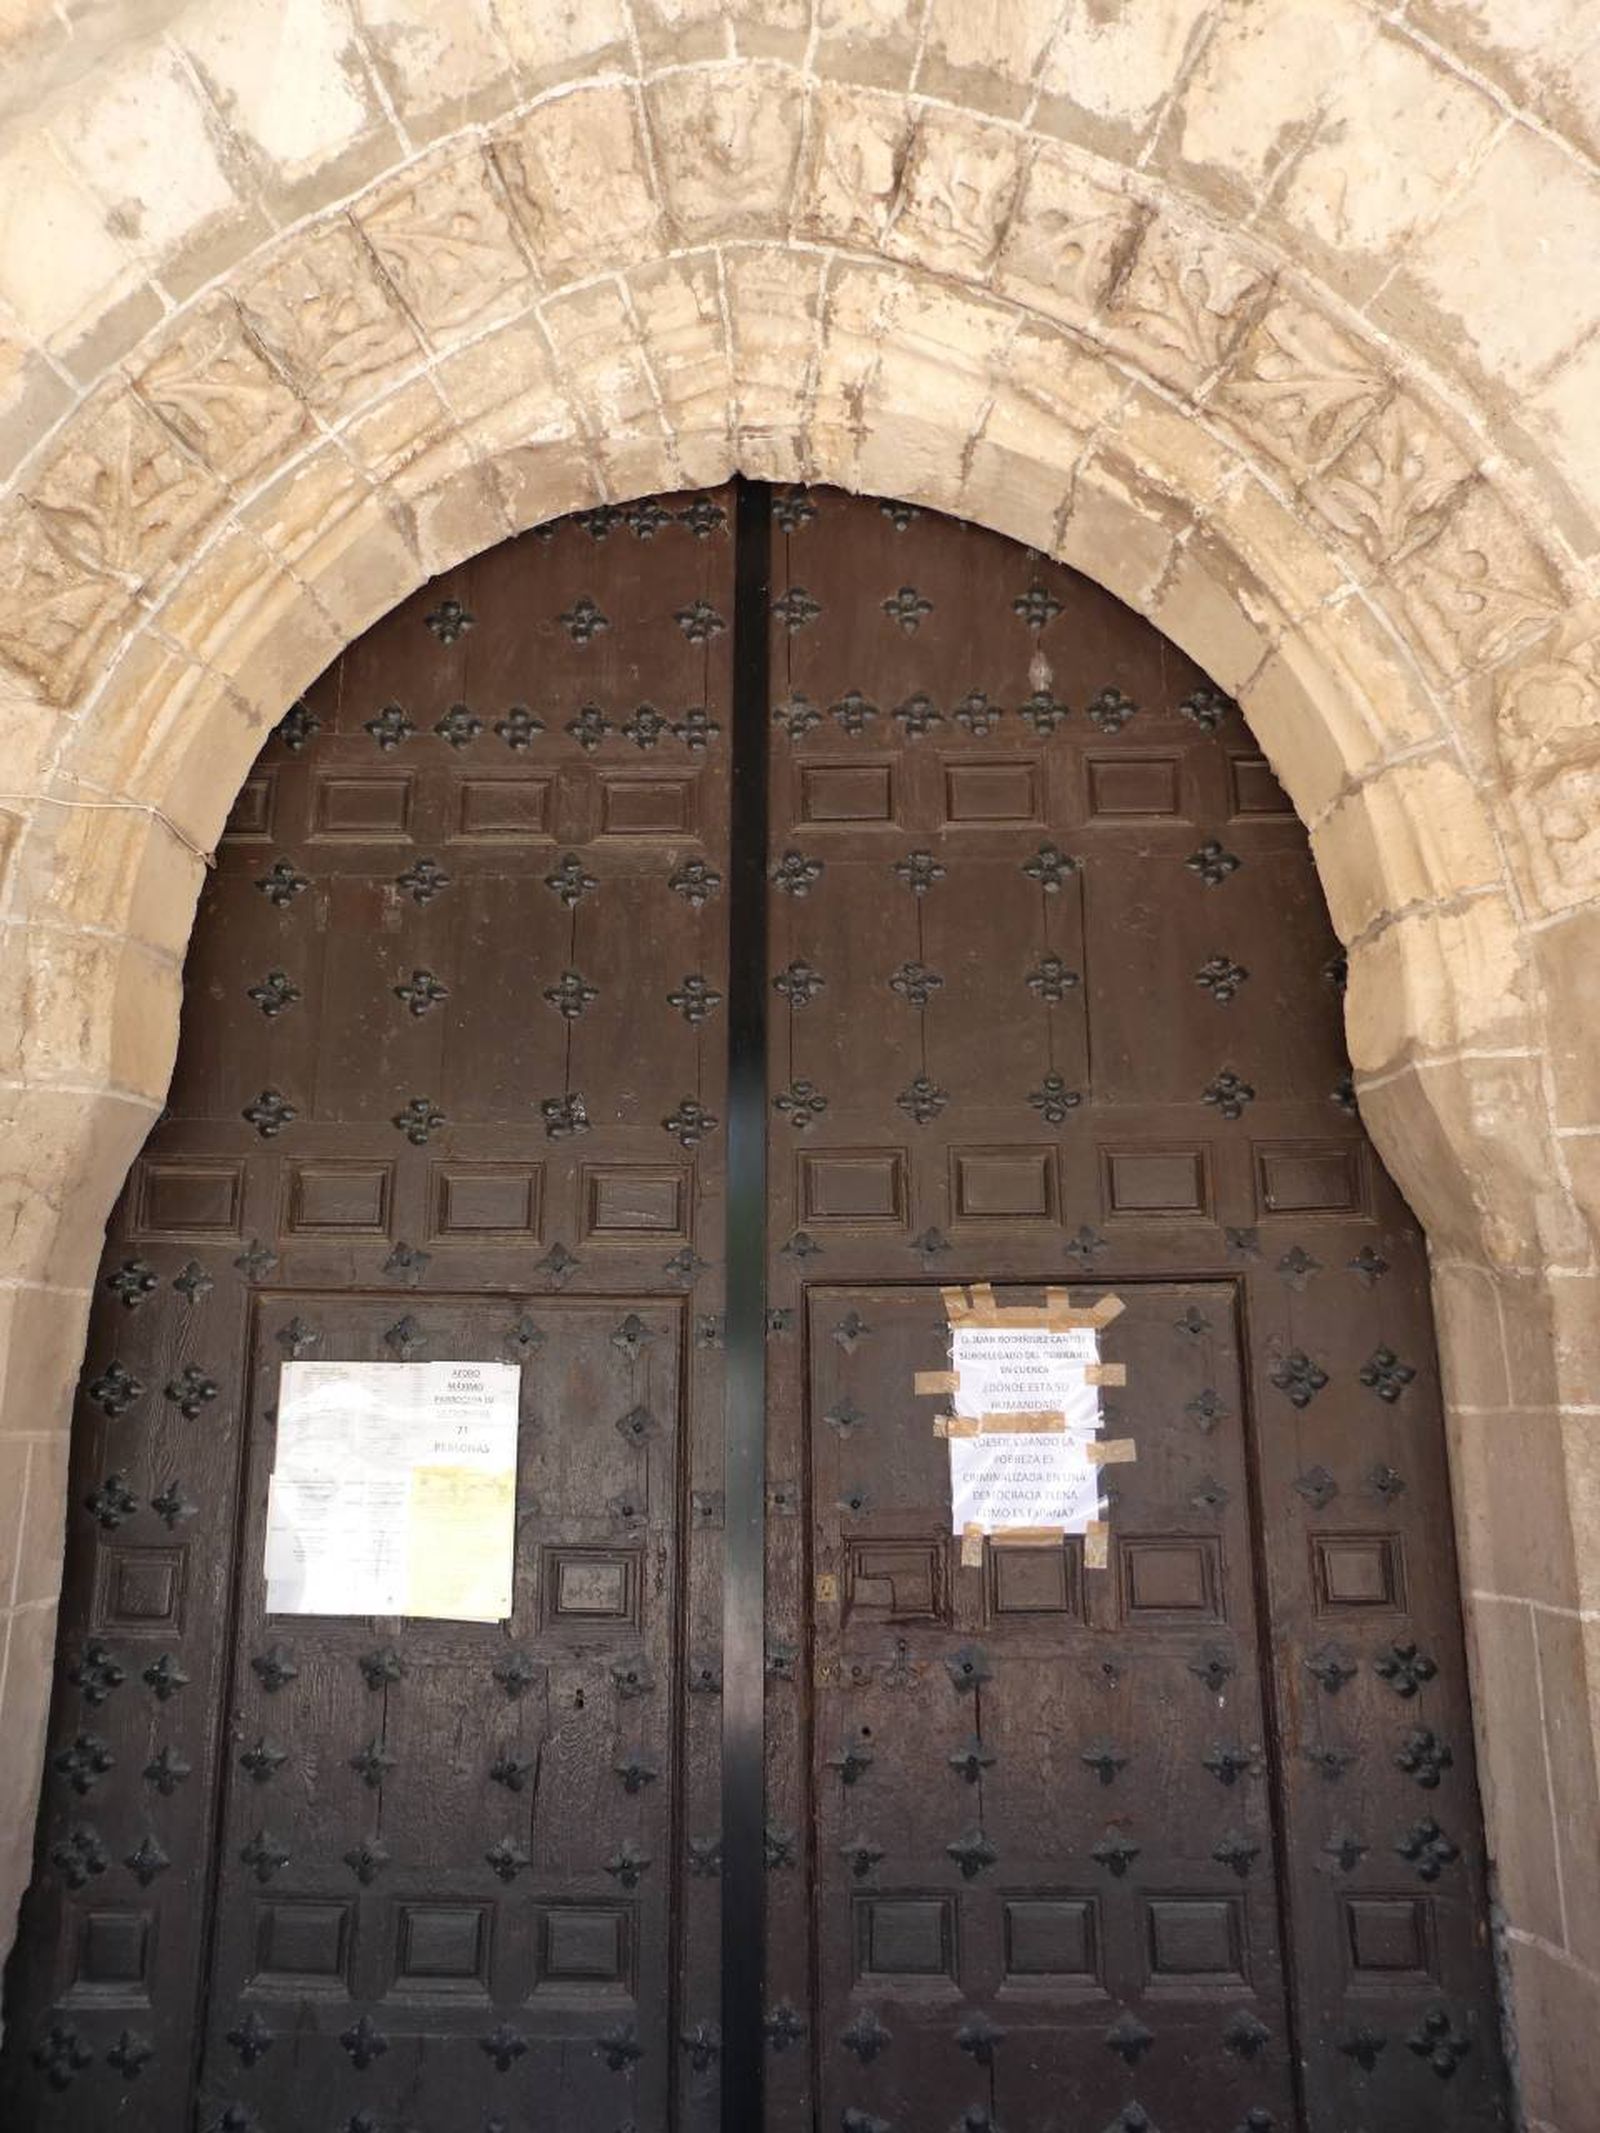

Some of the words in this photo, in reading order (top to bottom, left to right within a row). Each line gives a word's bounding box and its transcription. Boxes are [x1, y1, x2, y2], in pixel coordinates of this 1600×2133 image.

[1000, 1366, 1012, 1374] EN
[1013, 1366, 1050, 1374] CUENCA
[1062, 1437, 1075, 1447] LA
[434, 1441, 490, 1454] PERSONAS
[994, 1454, 1041, 1464] POBREZA
[962, 1472, 1042, 1482] CRIMINALIZADA
[1046, 1472, 1060, 1482] EN
[1062, 1472, 1086, 1482] UNA
[972, 1490, 1041, 1500] DEMOCRACIA
